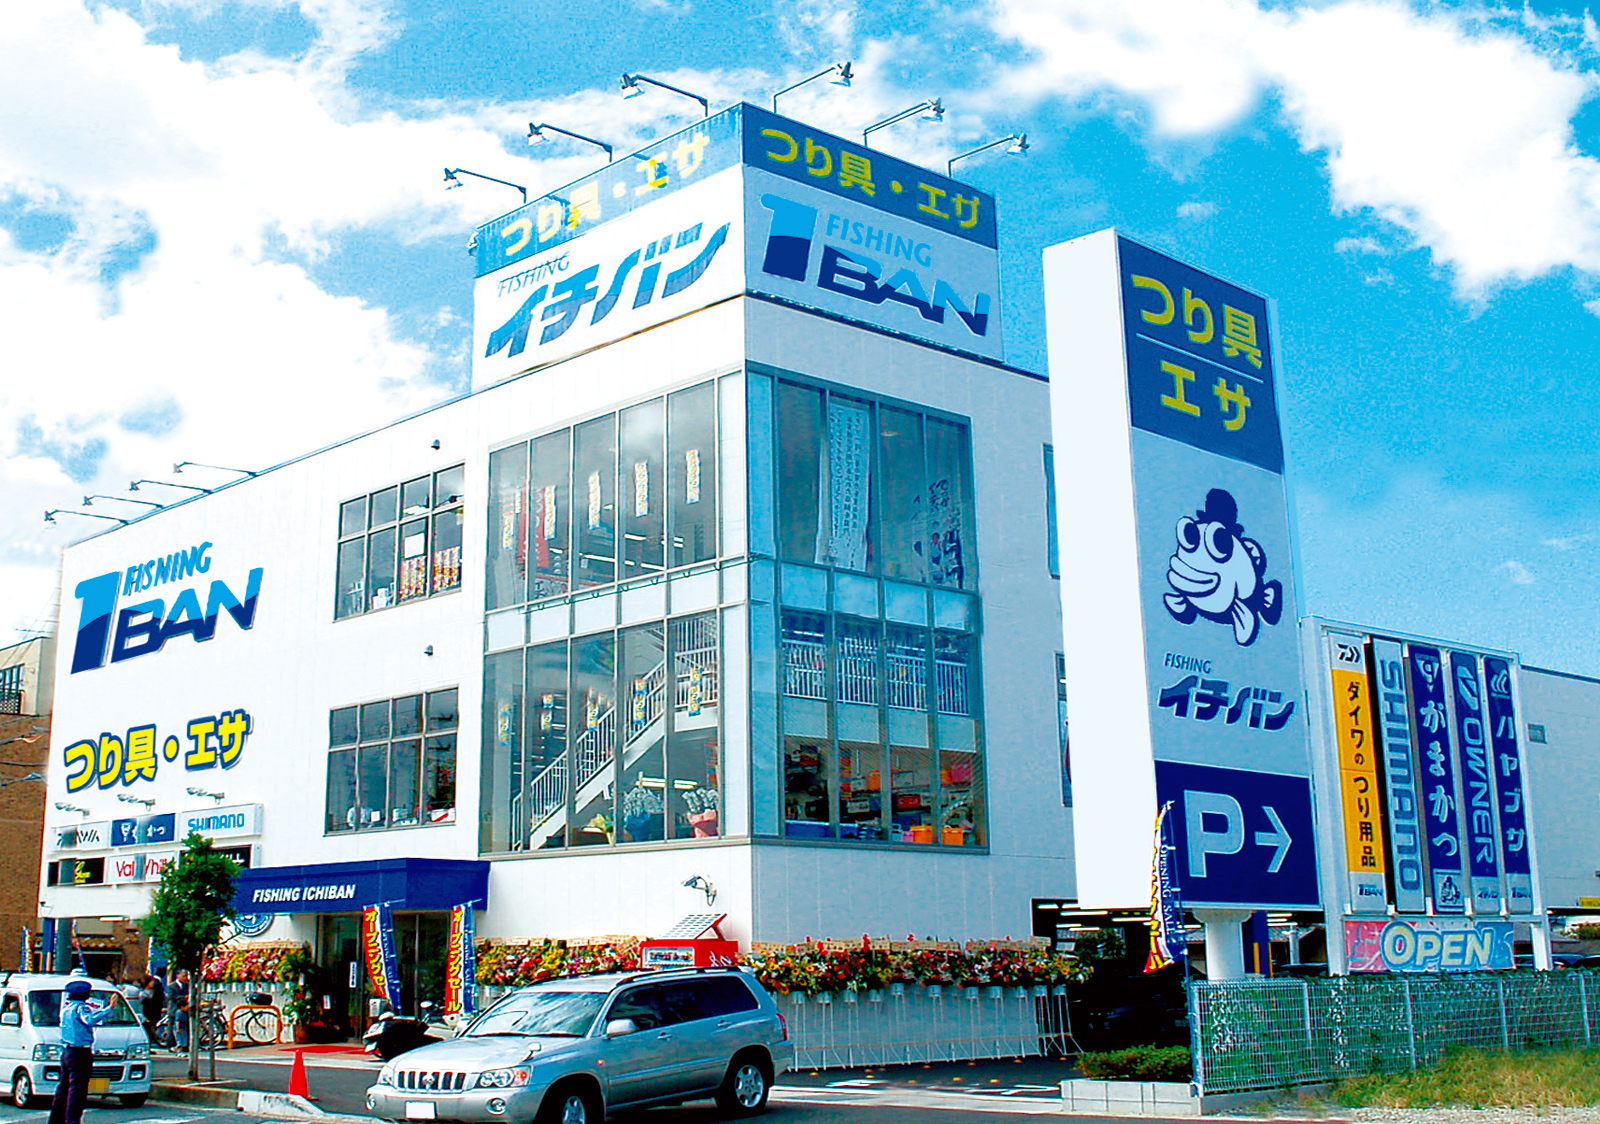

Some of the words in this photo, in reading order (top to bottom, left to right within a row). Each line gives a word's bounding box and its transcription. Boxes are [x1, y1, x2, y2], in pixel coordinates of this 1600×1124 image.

[502, 131, 710, 256] つり具・エサ
[762, 128, 980, 229] つり具・エサ
[497, 251, 571, 298] FISHING
[826, 213, 932, 267] FISHING
[484, 221, 731, 358] イチバン
[1131, 274, 1263, 369] つり具
[1160, 360, 1251, 431] エサ
[122, 541, 213, 597] FISHING
[1157, 674, 1296, 731] イチバン
[1164, 652, 1212, 675] FISHING
[64, 709, 249, 793] つり具・エサ
[1380, 659, 1421, 891] SHIMANO
[1420, 700, 1458, 856] がまかつ
[1463, 717, 1495, 863] OWNER
[1496, 715, 1527, 852] ハヤブサ
[187, 812, 245, 834] SHIMANO
[1183, 789, 1245, 878] P
[252, 887, 301, 903] FISHING
[302, 884, 356, 901] ICHIBAN
[1382, 922, 1495, 970] OPEN
